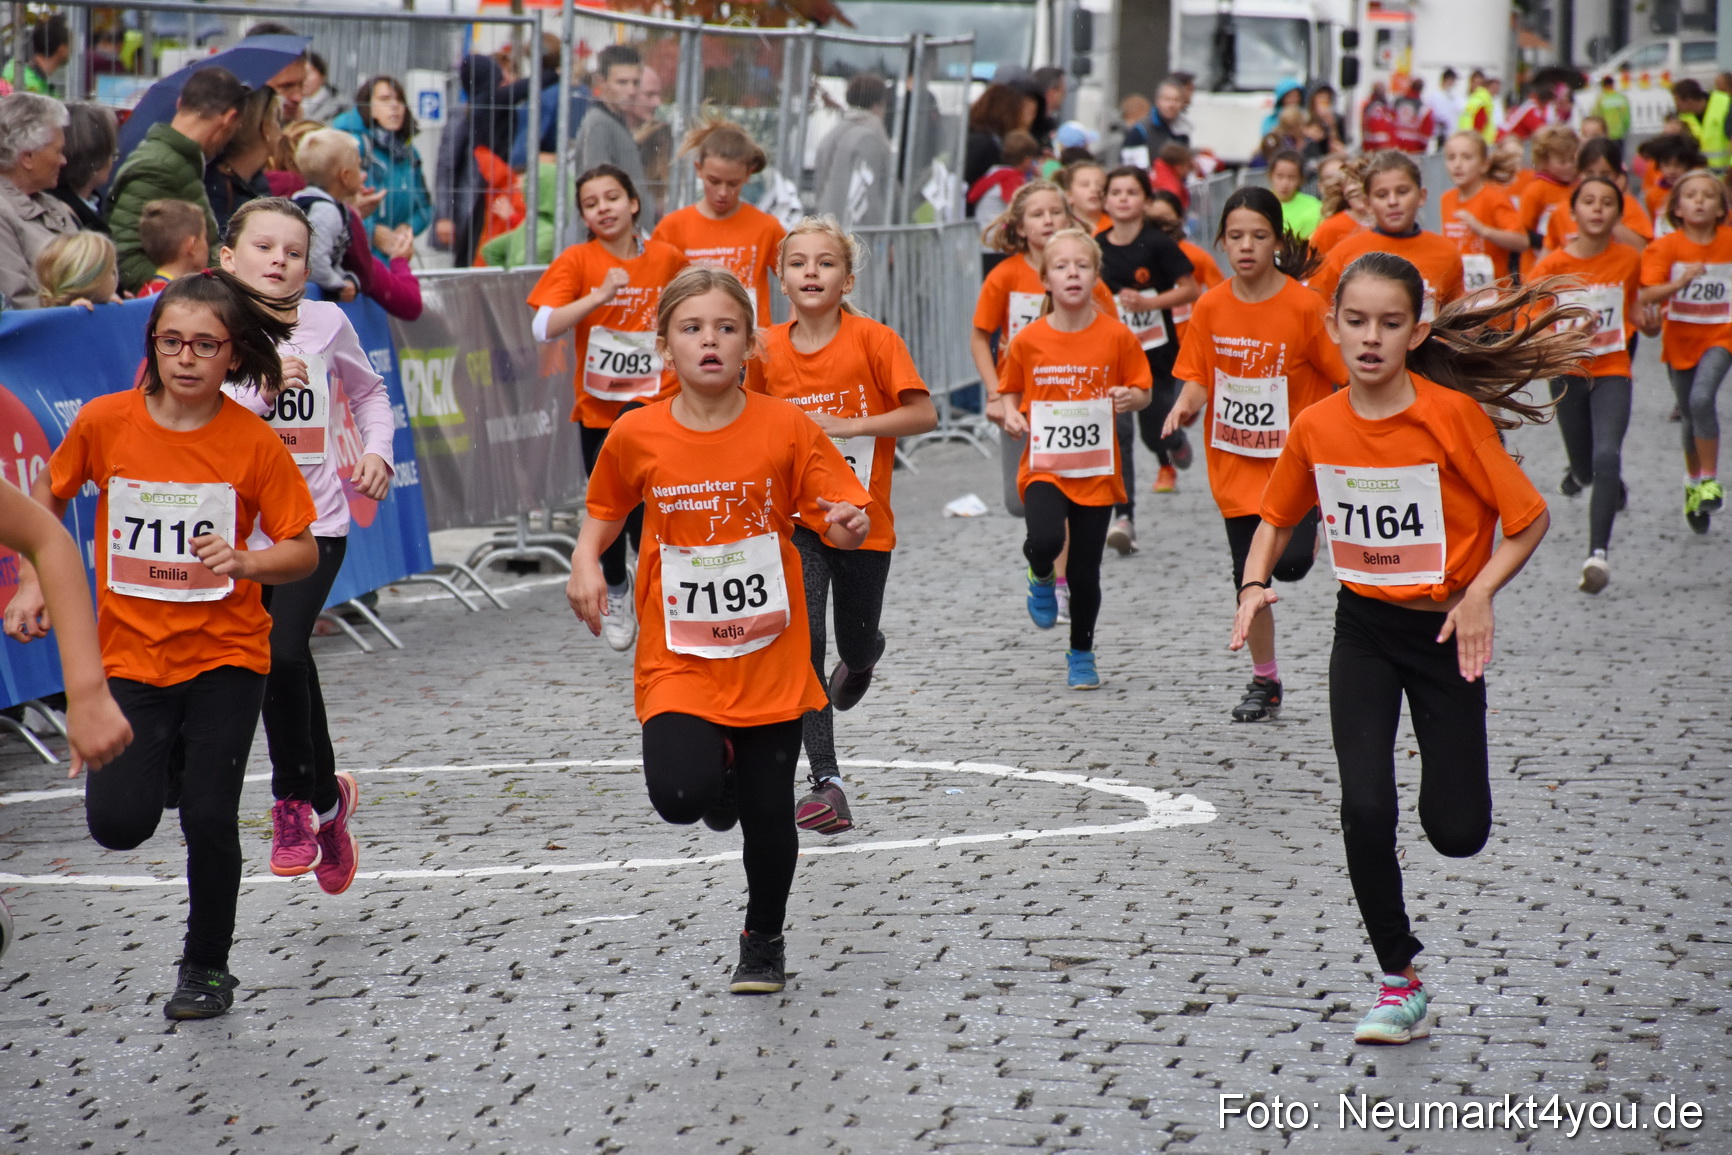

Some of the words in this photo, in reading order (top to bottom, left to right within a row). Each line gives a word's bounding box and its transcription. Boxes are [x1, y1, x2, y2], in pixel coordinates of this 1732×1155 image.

[421, 94, 439, 119] P
[599, 349, 652, 374] 7093
[1222, 396, 1276, 427] 7282
[1043, 423, 1101, 449] 7393
[1221, 425, 1281, 449] SARAH
[651, 479, 737, 499] Neumarkter
[1357, 479, 1400, 490] BOCK
[152, 493, 199, 505] BOCK
[658, 495, 721, 515] Stadtlauf
[1337, 502, 1425, 540] 7164
[702, 550, 746, 567] BOCK
[1362, 551, 1401, 566] Selma
[149, 565, 189, 581] Emilia
[679, 573, 768, 615] 7193
[711, 624, 745, 640] Katja
